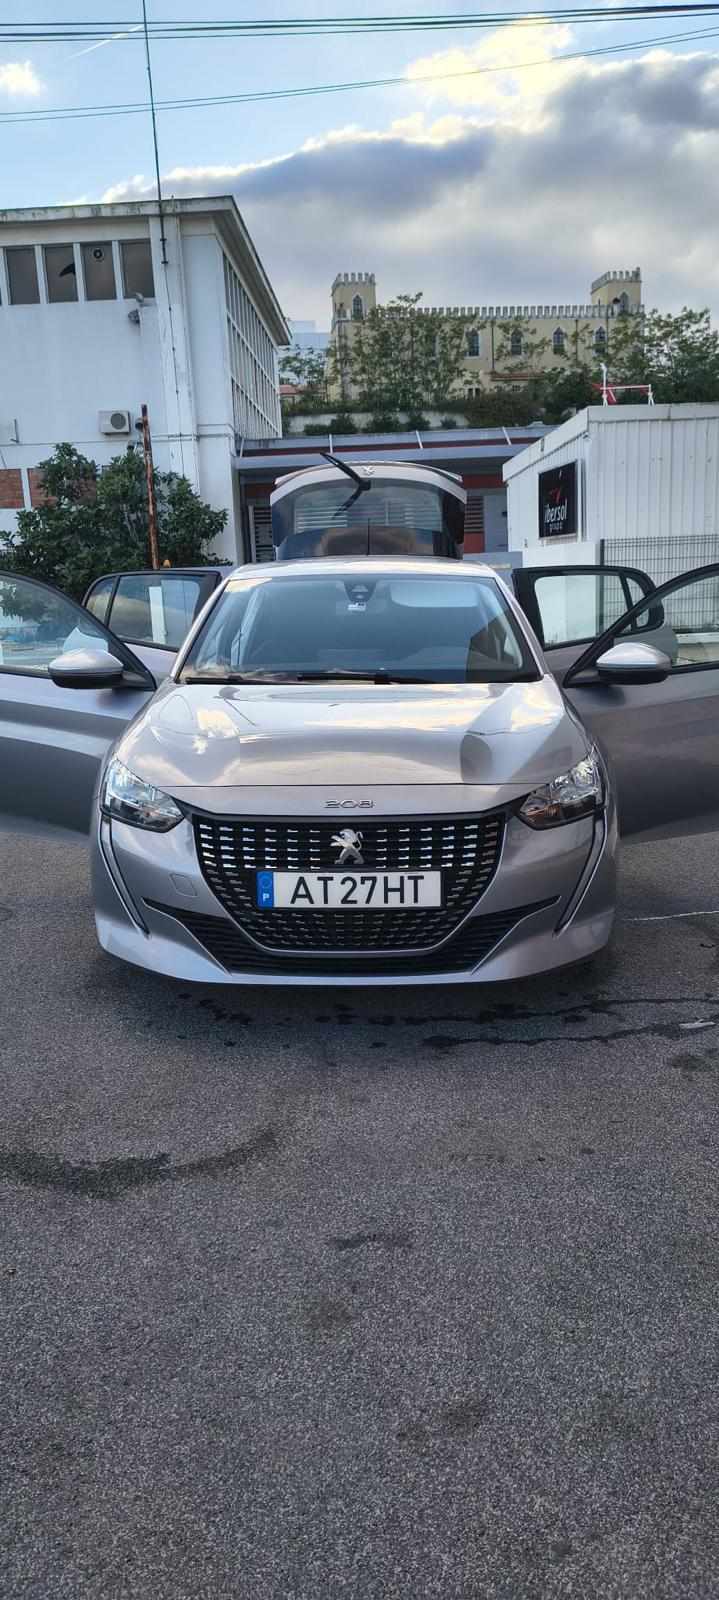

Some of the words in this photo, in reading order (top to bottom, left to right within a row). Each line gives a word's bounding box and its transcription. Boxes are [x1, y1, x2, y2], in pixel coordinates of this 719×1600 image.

[544, 498, 568, 522] ibersol
[324, 799, 375, 808] 208
[262, 893, 271, 901] P
